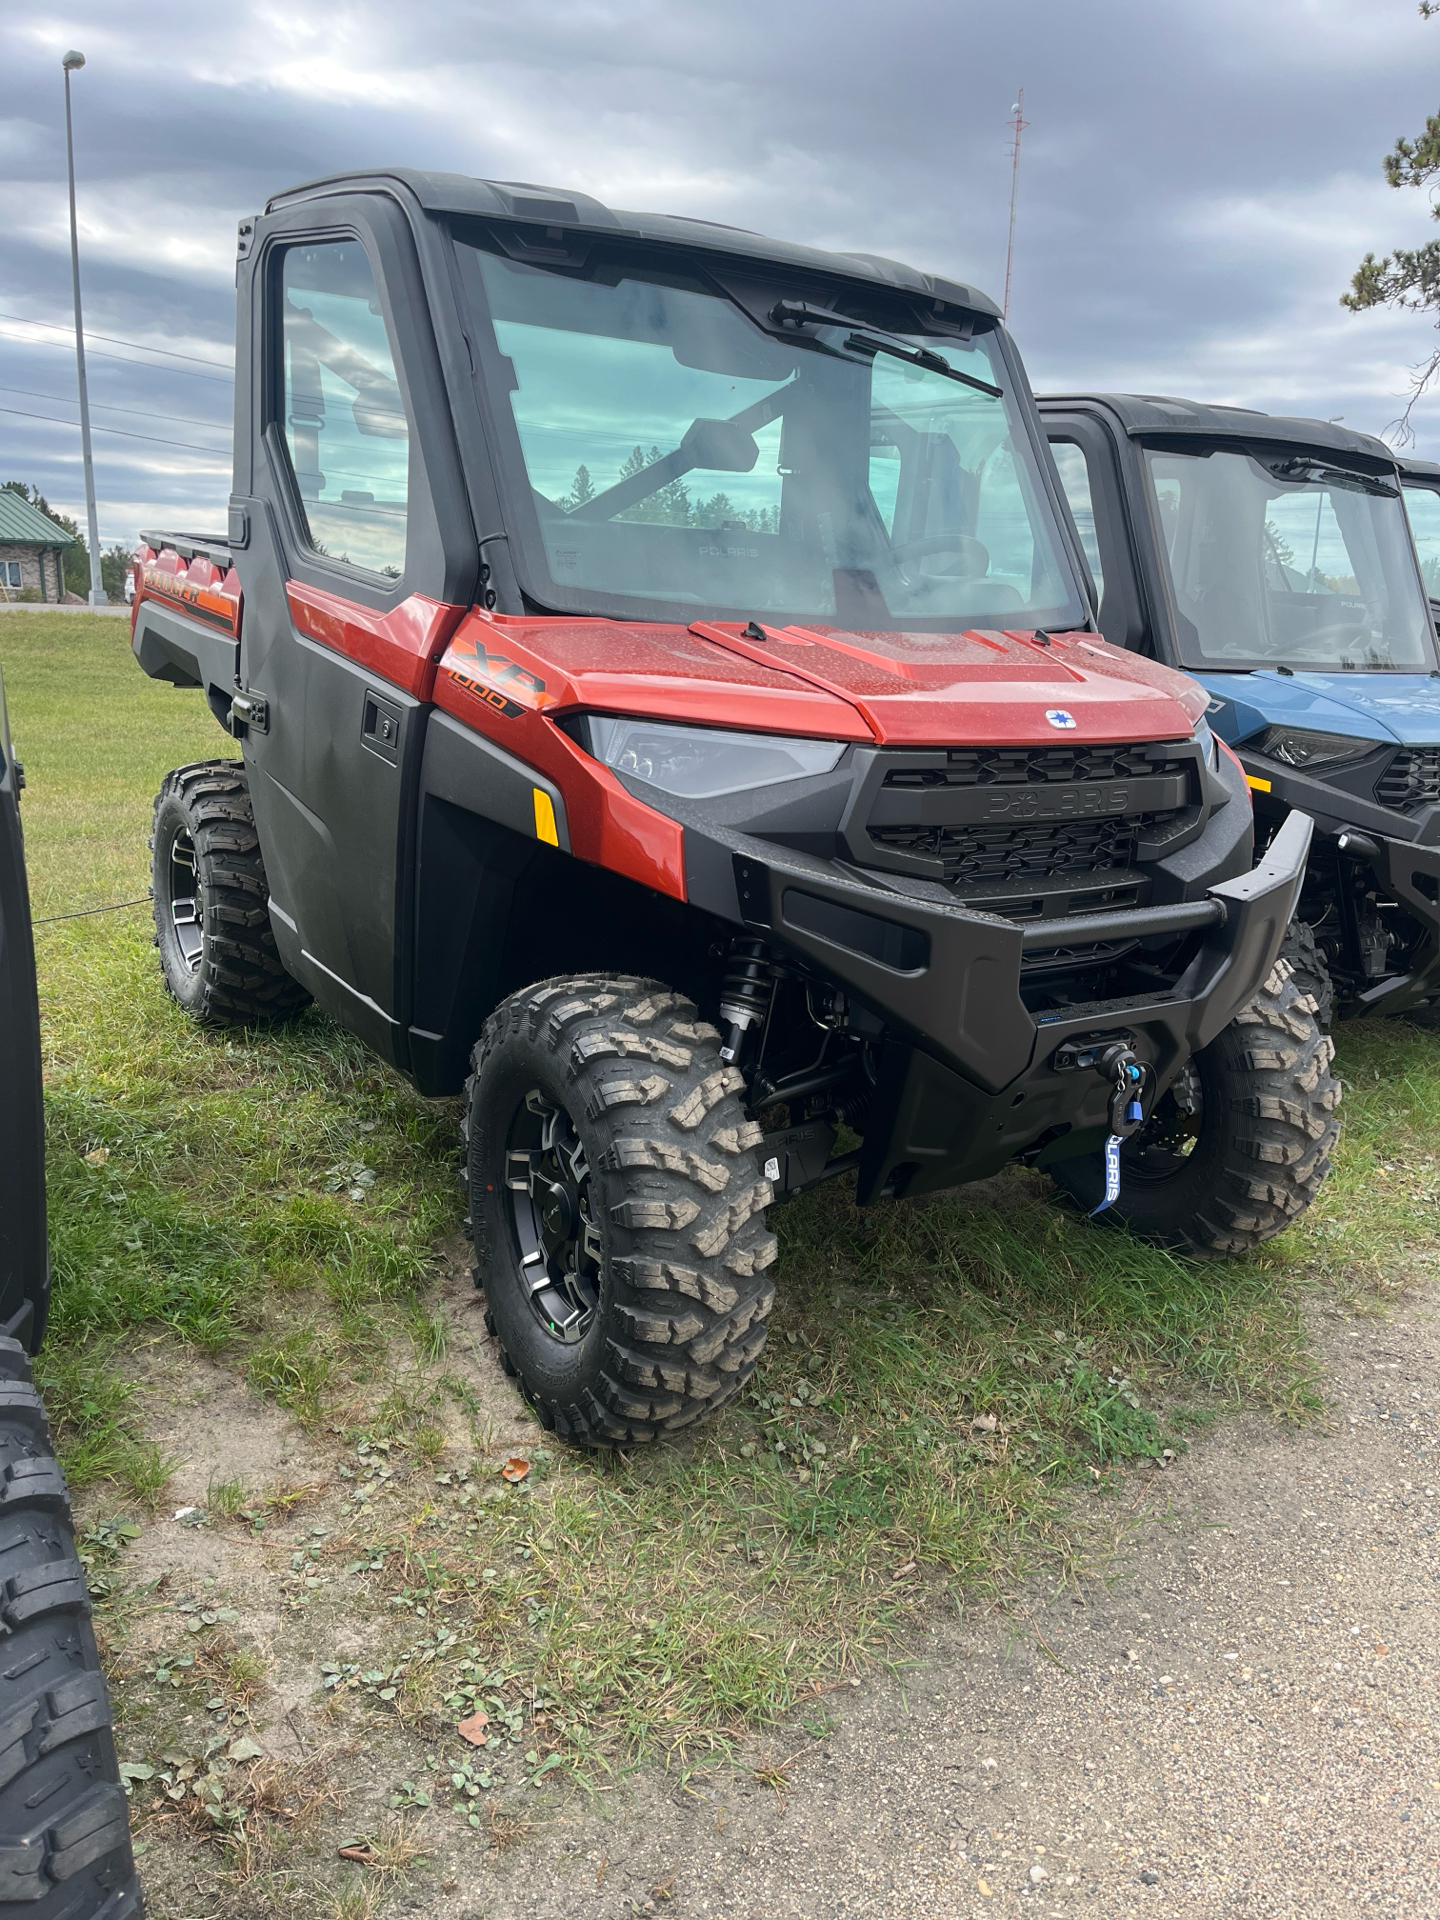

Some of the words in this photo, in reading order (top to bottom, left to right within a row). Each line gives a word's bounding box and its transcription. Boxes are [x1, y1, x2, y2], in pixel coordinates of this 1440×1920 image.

[698, 546, 759, 558] POLARIS
[147, 570, 200, 603] RANGER
[1340, 601, 1367, 610] POLAR
[453, 639, 546, 693] XP
[447, 664, 508, 710] 1000
[982, 785, 1129, 819] POLARIS
[754, 1129, 815, 1153] OLARIS
[1107, 1134, 1124, 1202] OLARIS
